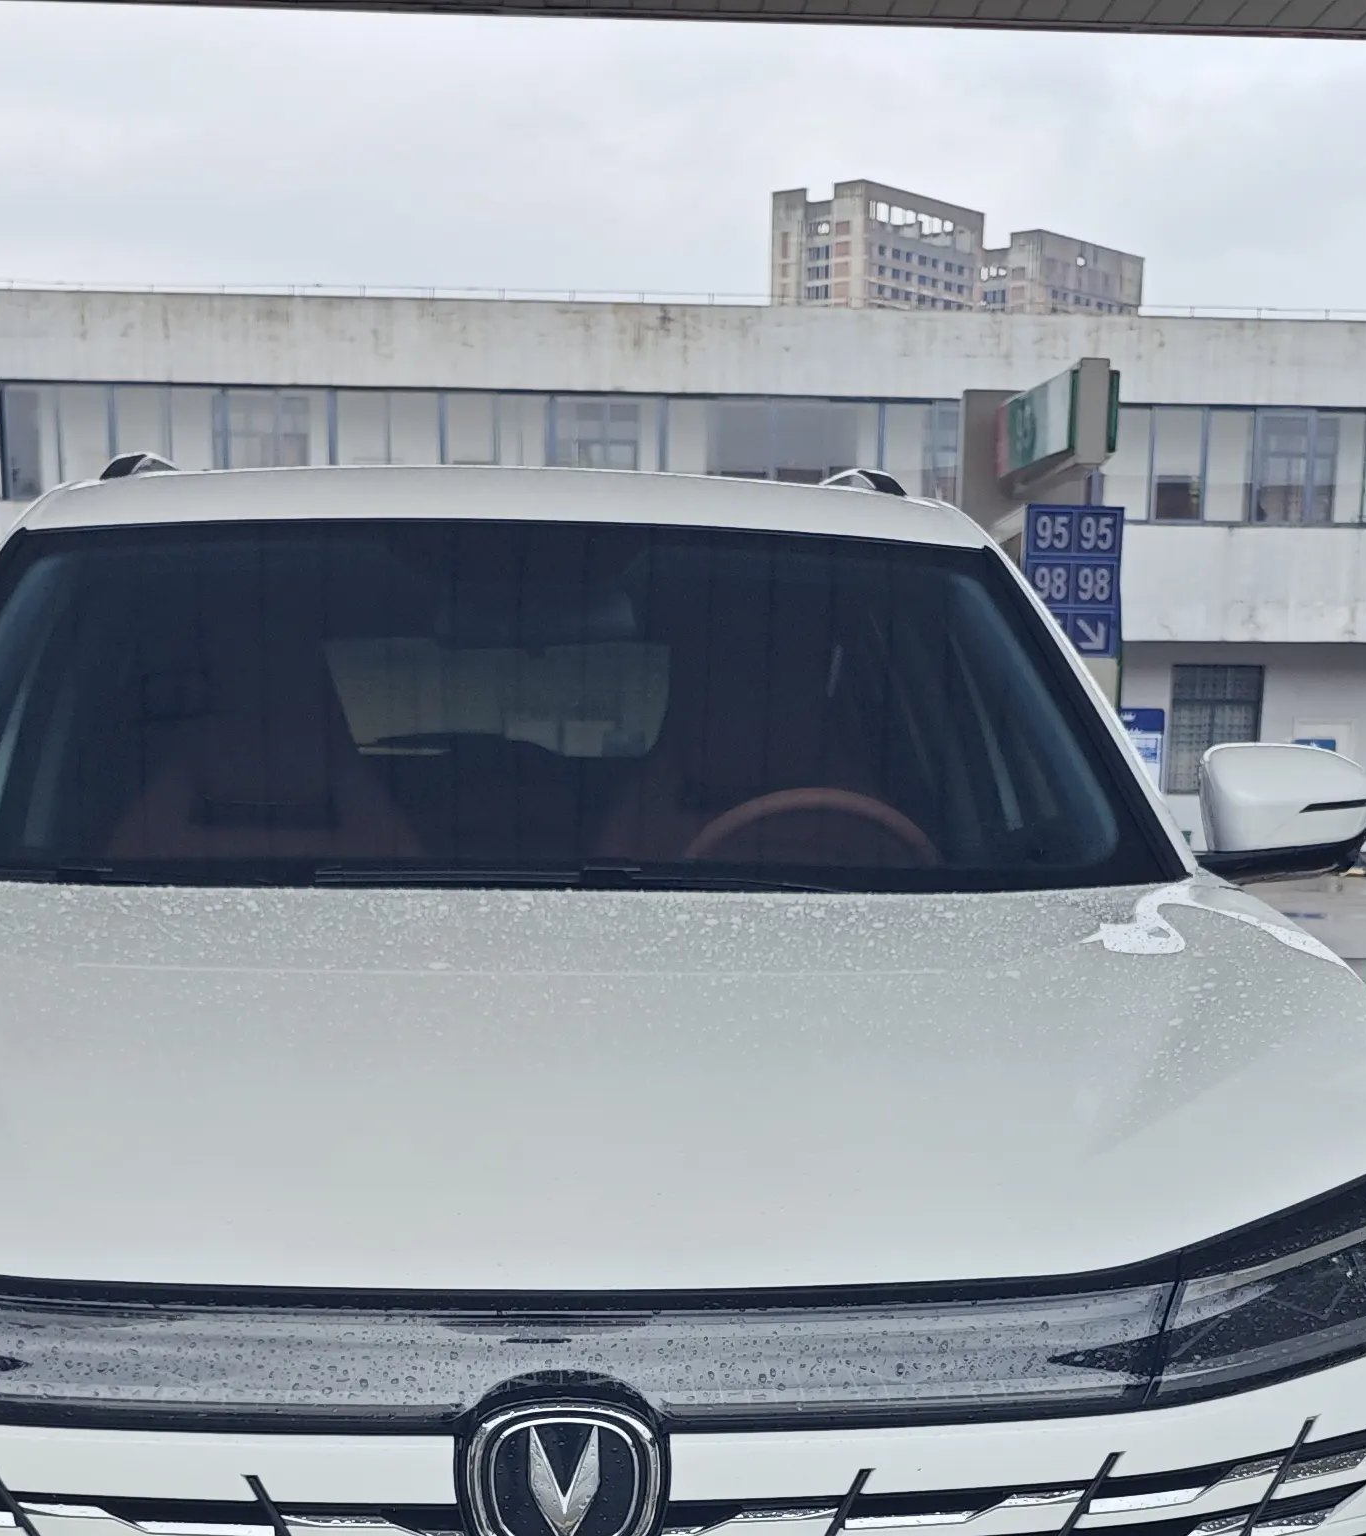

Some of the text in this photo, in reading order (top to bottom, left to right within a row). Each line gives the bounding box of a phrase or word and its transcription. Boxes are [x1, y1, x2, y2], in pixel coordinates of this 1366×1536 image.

[1036, 516, 1114, 550] 95 95
[1035, 567, 1111, 601] 98 98
